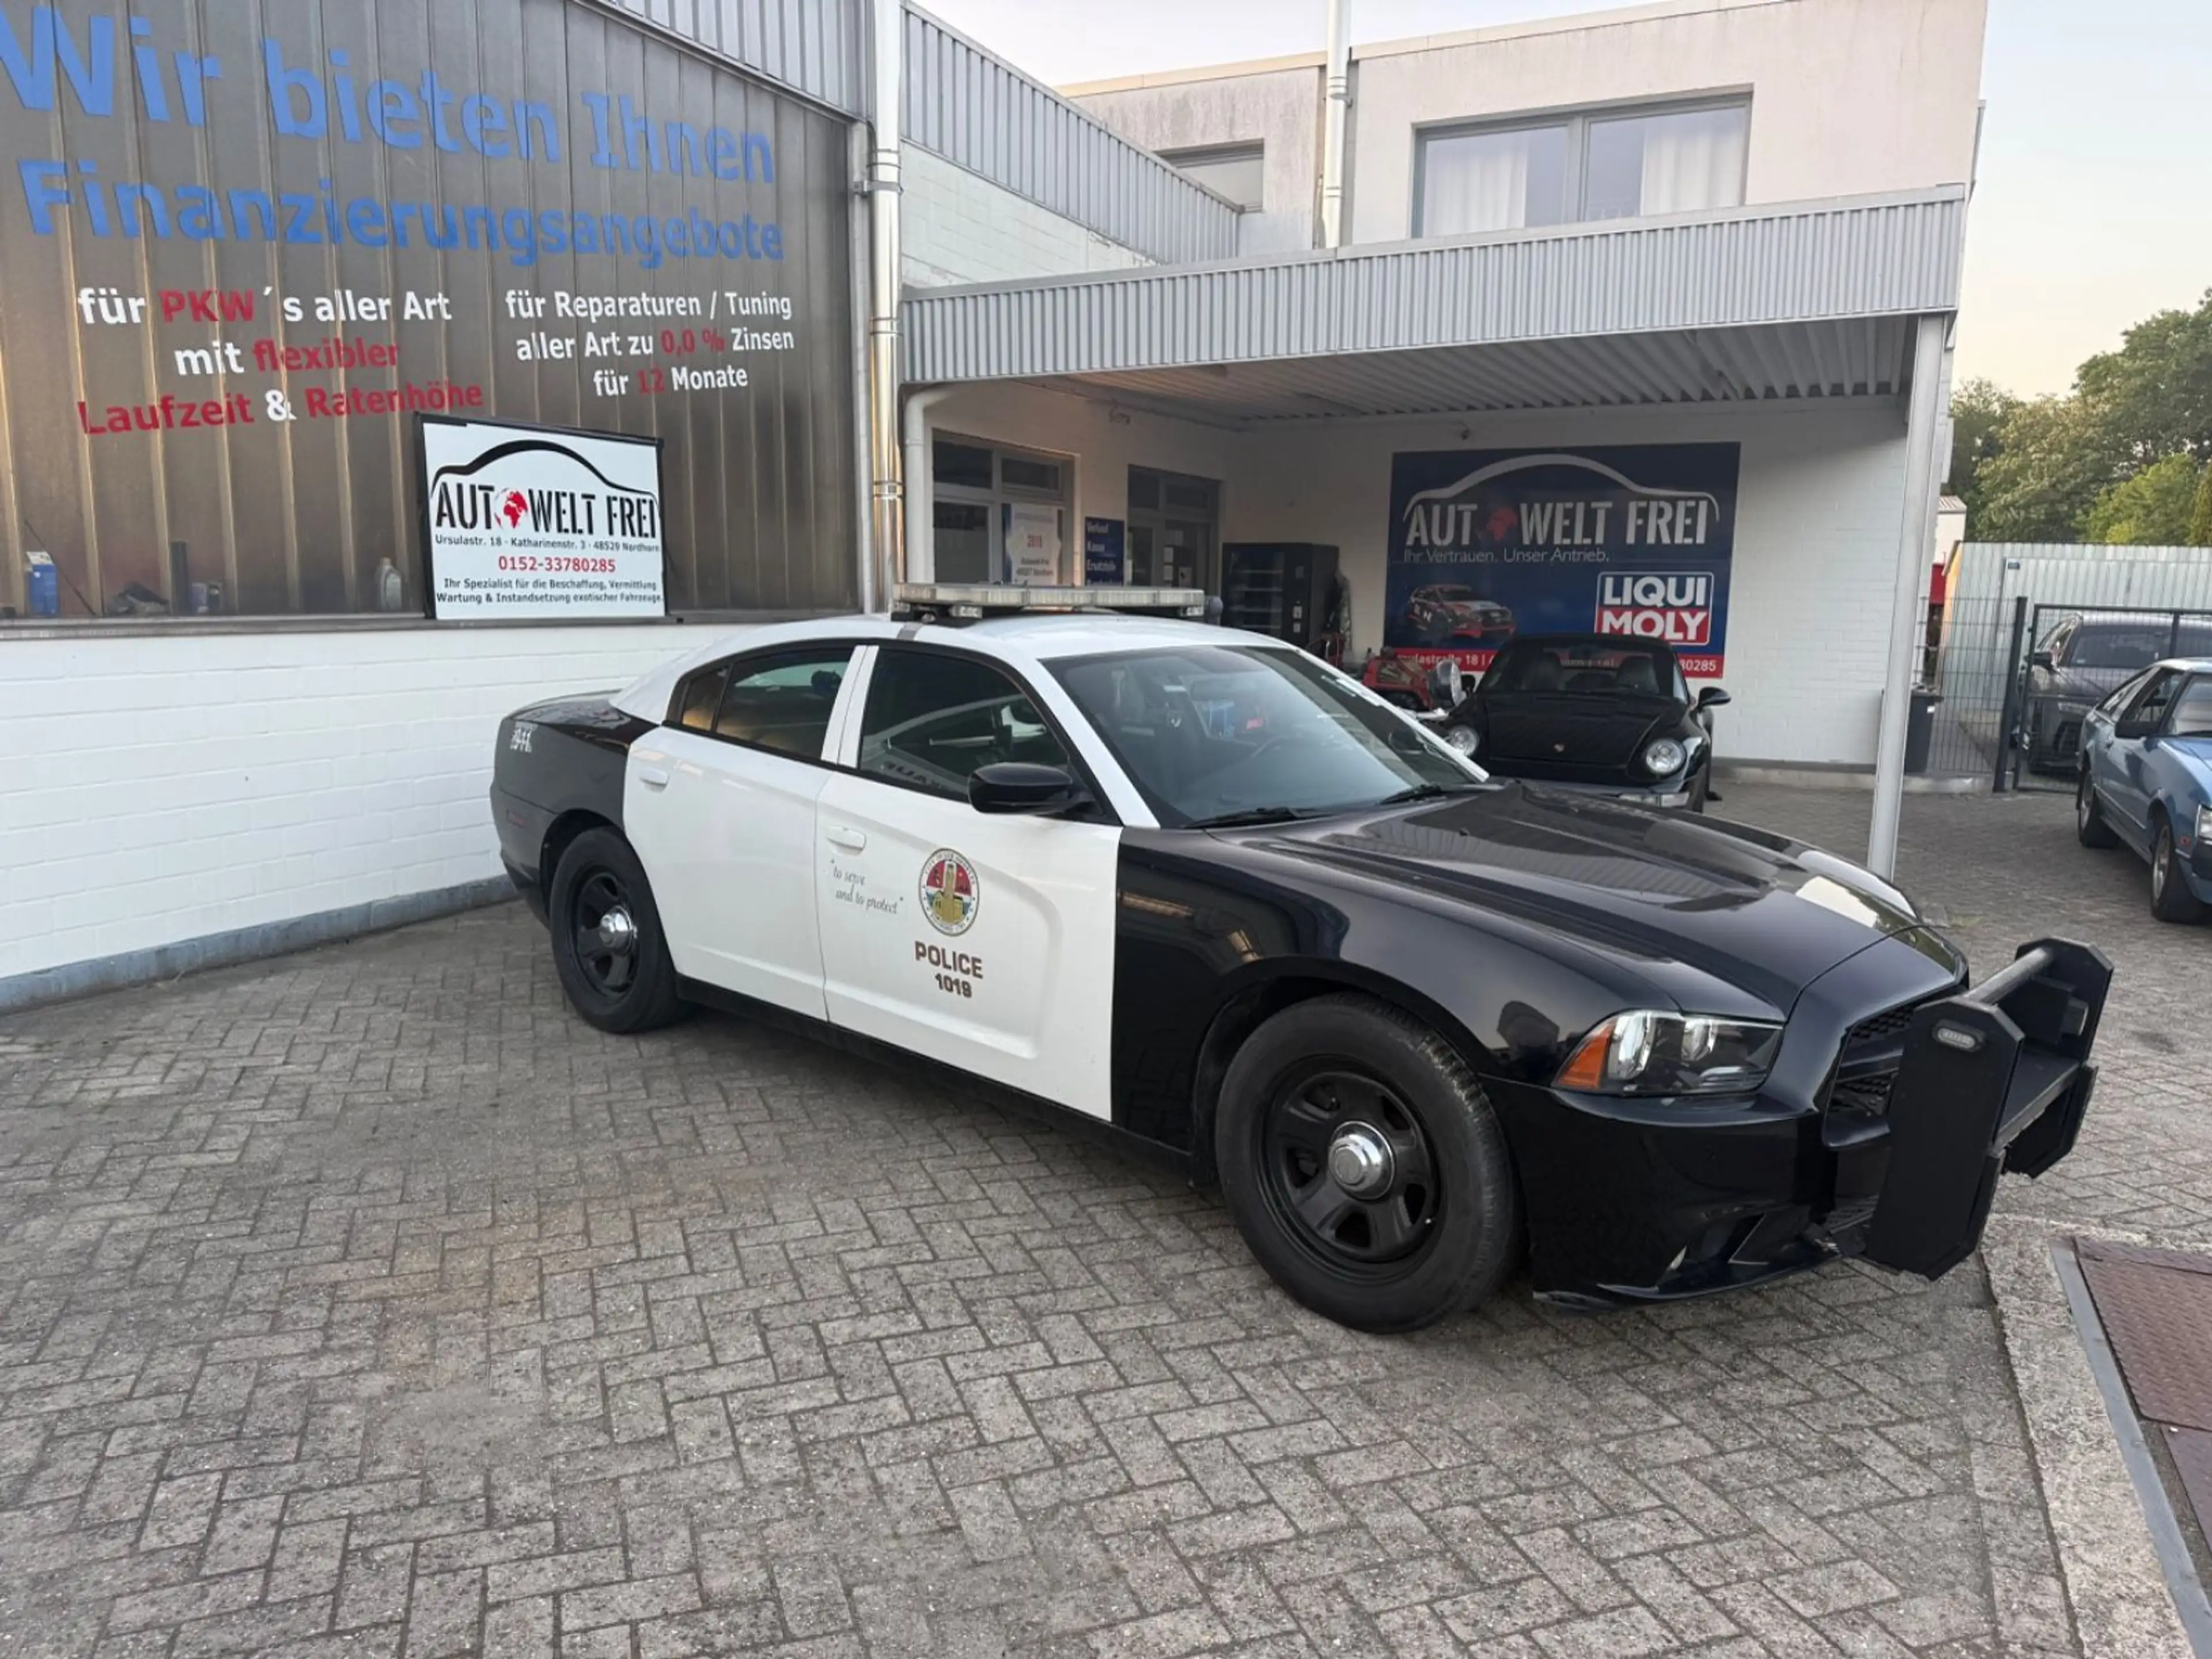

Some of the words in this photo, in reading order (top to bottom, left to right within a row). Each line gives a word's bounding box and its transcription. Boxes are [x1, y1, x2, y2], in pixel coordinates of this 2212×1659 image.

[0, 3, 221, 127] Wir
[263, 38, 560, 163] bieten
[582, 90, 775, 184] Ihnen
[18, 158, 784, 269] Finanzierungsangebote
[77, 288, 146, 324] für
[315, 291, 391, 322] aller
[404, 291, 452, 320] Art
[505, 290, 546, 319] für
[555, 291, 701, 323] Reparaturen
[725, 292, 792, 320] Tuning
[175, 341, 244, 376] mit
[253, 339, 399, 372] flexibler
[517, 332, 575, 361] aller
[584, 332, 622, 358] Art
[628, 336, 654, 357] zu
[661, 330, 695, 355] 0,0
[703, 328, 725, 353] %
[731, 328, 794, 352] Zinsen
[593, 370, 628, 396] für
[637, 369, 665, 393] 12
[672, 365, 748, 392] Monate
[78, 394, 253, 434] Laufzeit
[265, 390, 297, 421] &
[305, 380, 483, 418] Ratenhöhe
[607, 495, 656, 539] FREI
[1626, 500, 1708, 544] FREI
[435, 534, 487, 546] Ursulastr.
[490, 537, 502, 547] 18
[1404, 549, 1422, 563] Ihr
[1426, 548, 1498, 564] Vertrauen.
[1503, 547, 1548, 562] Unser
[1550, 546, 1609, 562] Antrieb.
[498, 555, 616, 573] 0152-33780285
[436, 592, 482, 604] Wartung
[497, 593, 571, 604] Instandsetzung
[444, 578, 461, 588] Ihr
[464, 578, 513, 590] Spezialist
[516, 578, 529, 589] für
[532, 578, 547, 589] die
[1604, 576, 1706, 608] LIQUI
[1601, 609, 1707, 641] MOLY
[1467, 654, 1480, 666] 18
[914, 940, 984, 979] POLICE
